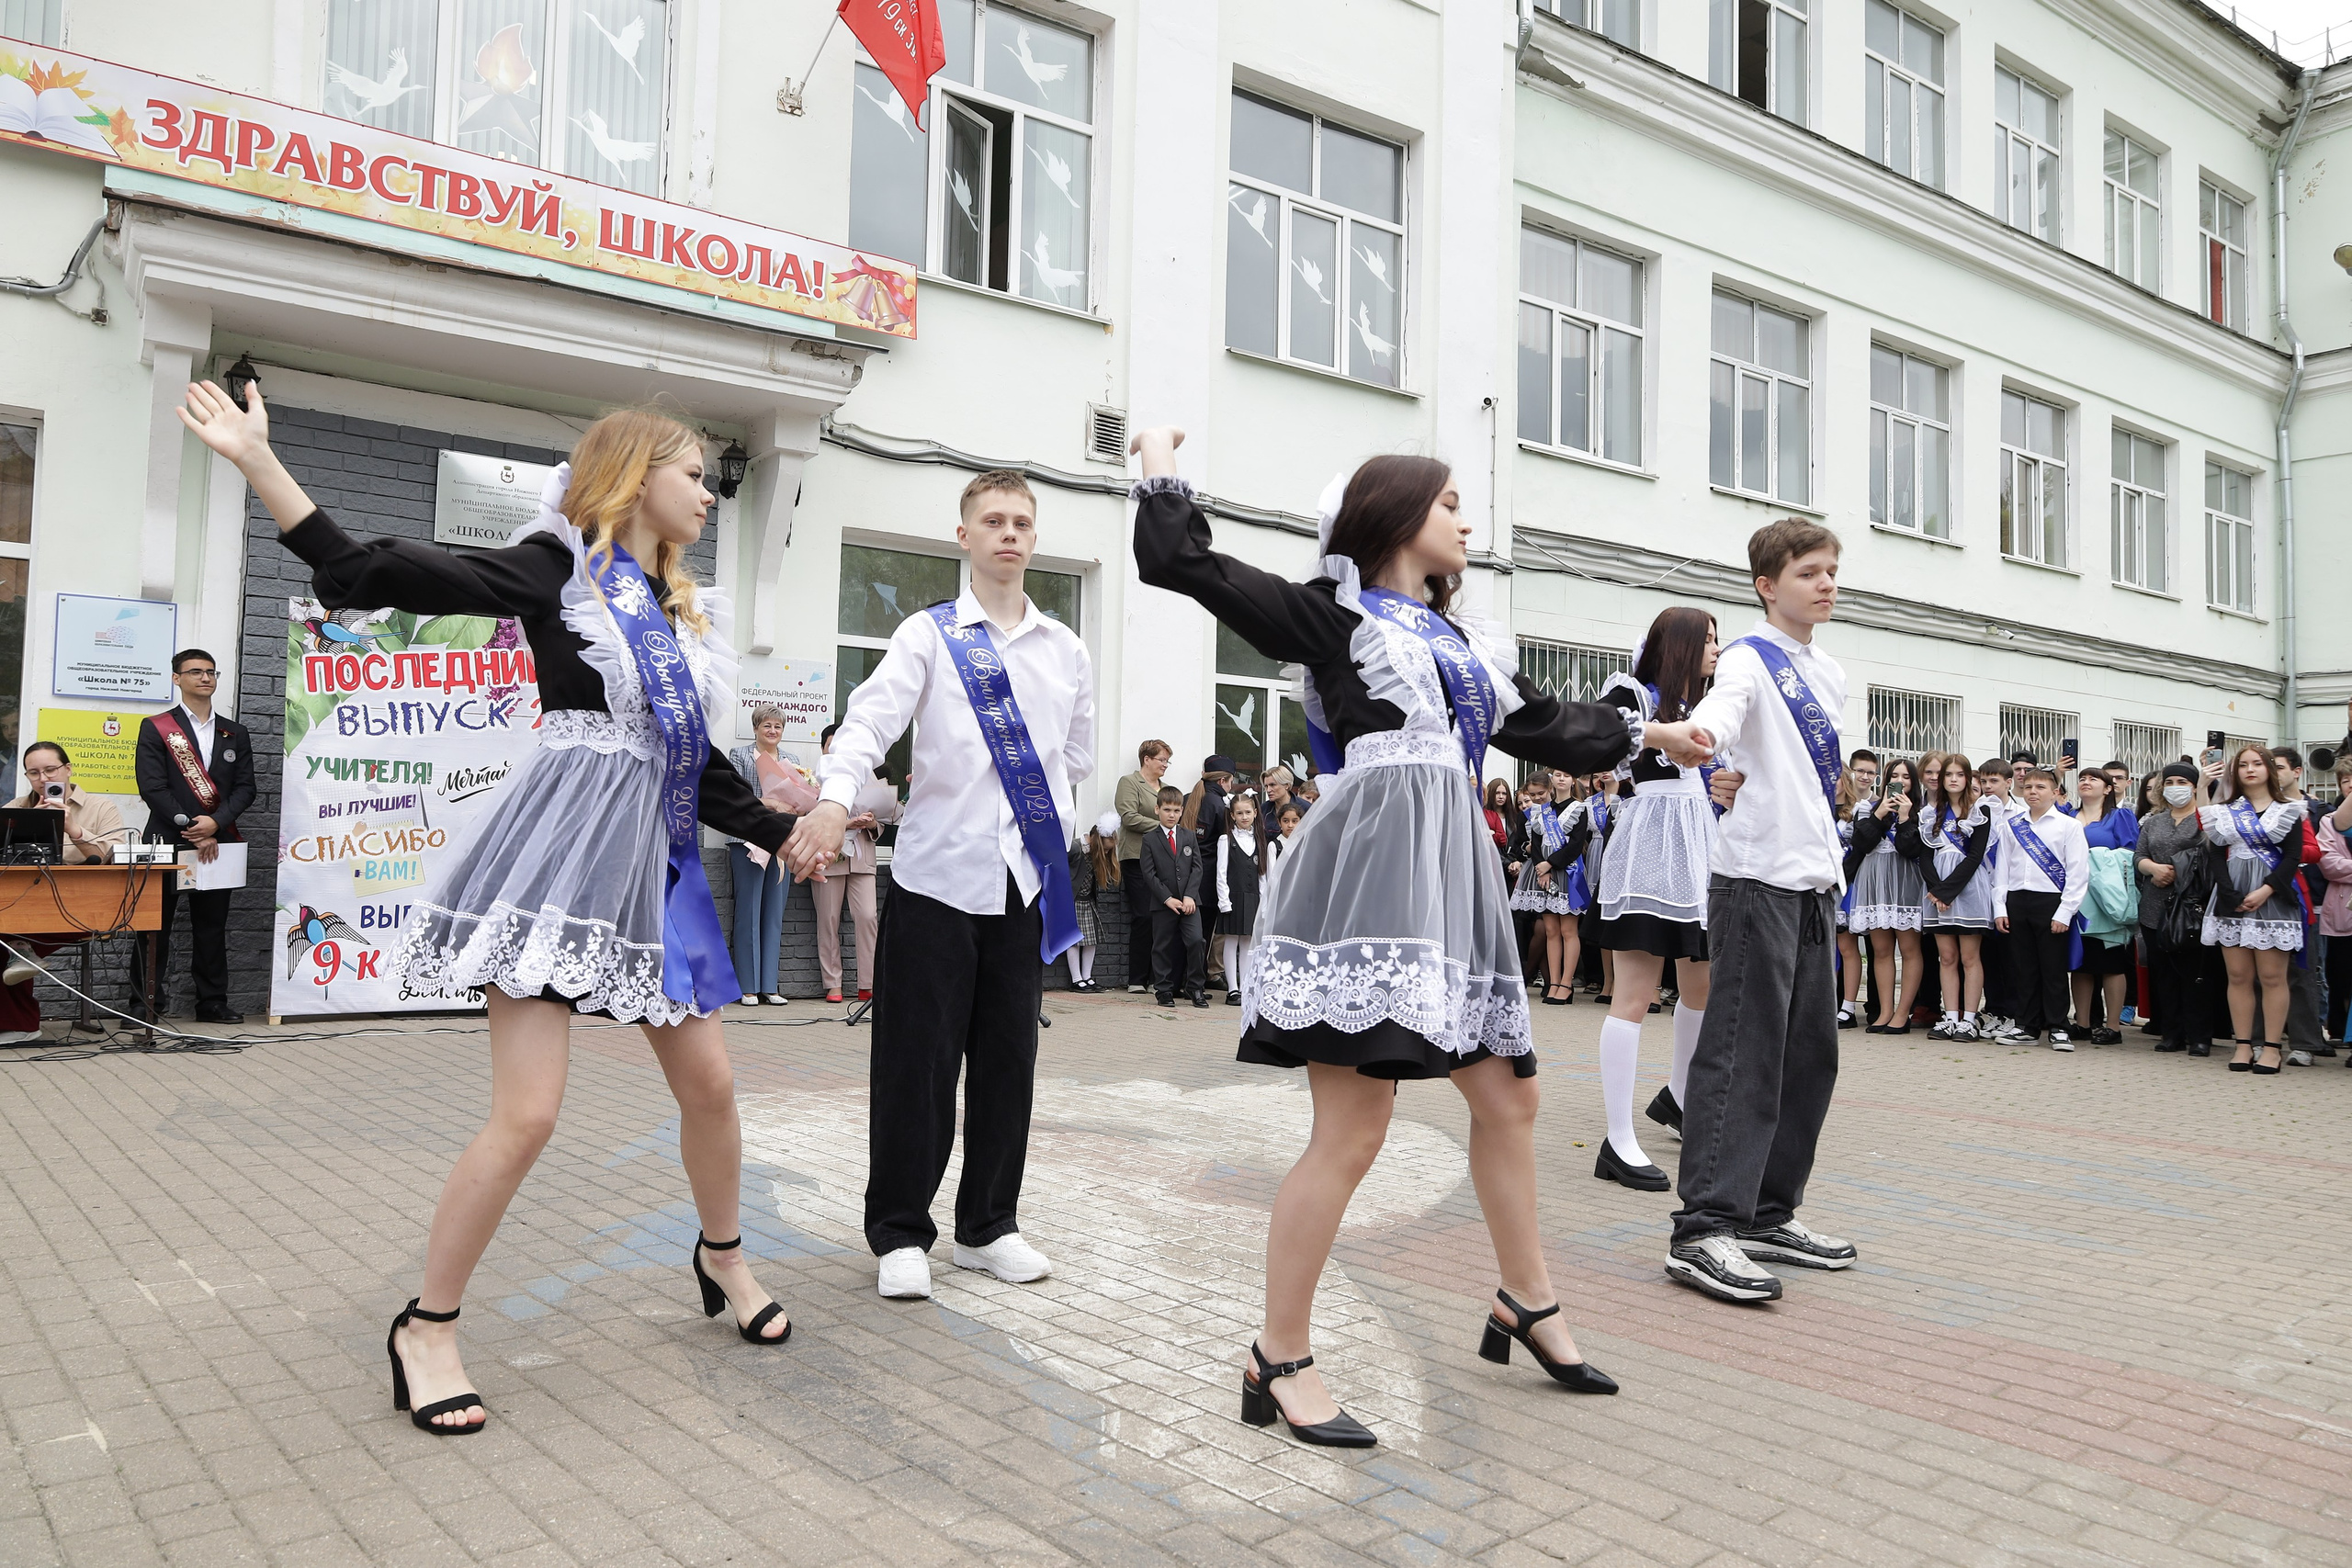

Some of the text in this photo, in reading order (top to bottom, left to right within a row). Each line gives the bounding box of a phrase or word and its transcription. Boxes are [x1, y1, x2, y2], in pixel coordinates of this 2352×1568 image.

[141, 98, 825, 299] ЗДРАВСТВУЙ, ШКОЛА!
[451, 498, 514, 512] МУНИЦИПАЛЬНОЕ
[77, 675, 118, 684] «Школа
[133, 678, 151, 686] 75»
[741, 687, 828, 701] ФЕДЕРАЛЬНЫЙ ПРОЕКТ
[337, 697, 514, 736] ВЫПУСК
[777, 702, 828, 713] КАЖДОГО
[56, 736, 120, 744] МУНИЦИПАЛЬНОЕ
[967, 648, 1055, 823] Выпускник 2025
[75, 751, 116, 760] «ШКОЛА
[175, 746, 213, 800] Выпускник
[306, 755, 433, 785] УЧИТЕЛЯ!
[318, 794, 417, 819] ВЫ ЛУЧШИЕ!
[673, 786, 694, 845] 2025
[290, 827, 447, 863] СПАСИБО
[365, 860, 417, 881] ВАМ!
[312, 940, 341, 987] 9
